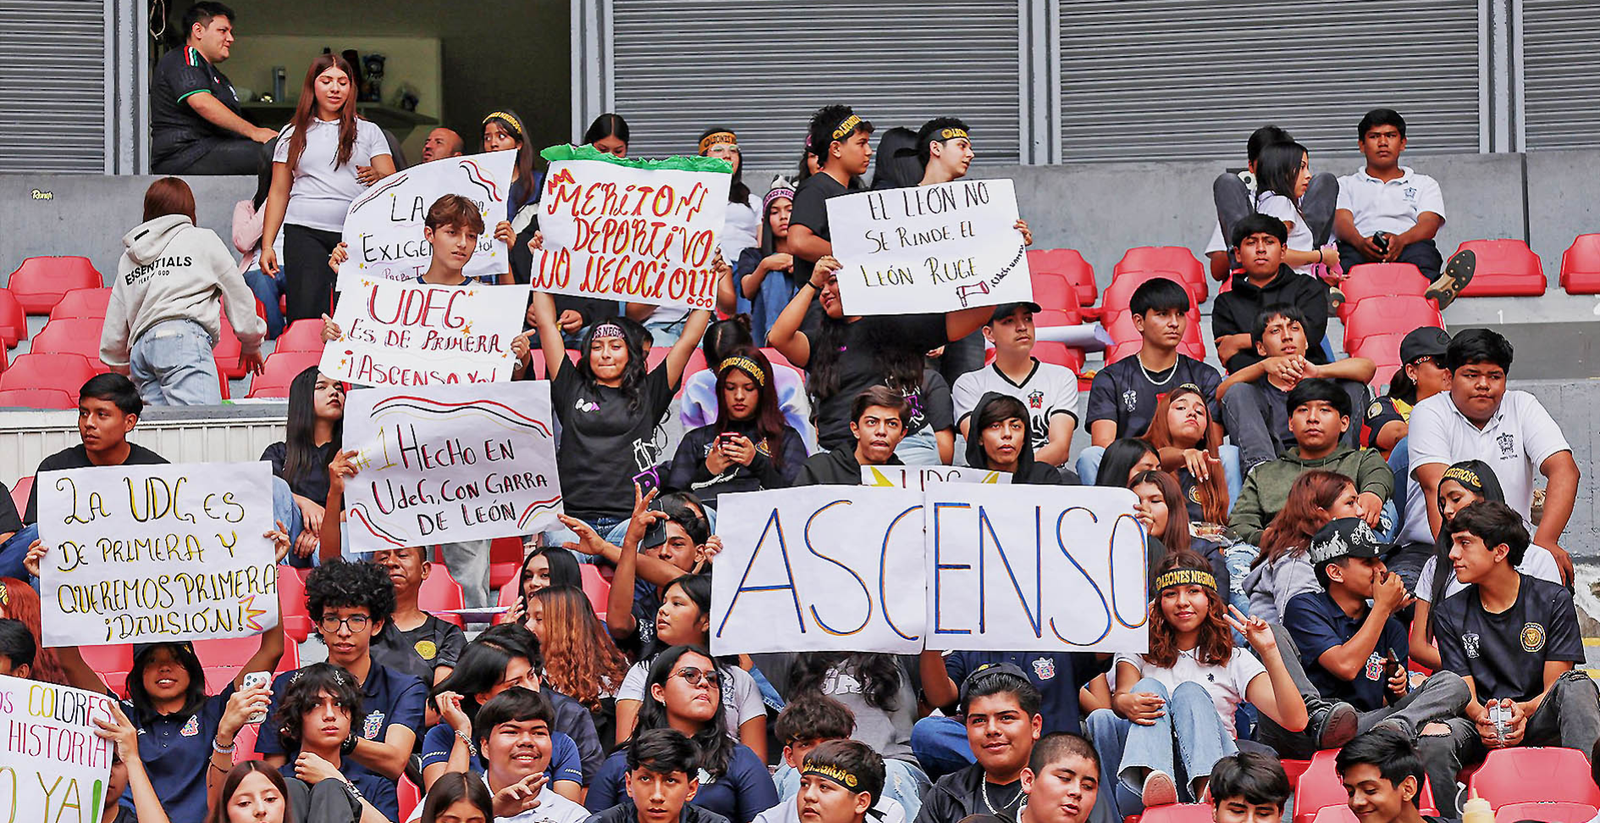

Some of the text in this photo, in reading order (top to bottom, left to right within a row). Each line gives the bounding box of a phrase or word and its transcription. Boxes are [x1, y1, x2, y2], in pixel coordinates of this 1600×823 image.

[867, 181, 990, 221] EL LEÓN NO
[362, 235, 433, 263] EXIGE
[864, 228, 891, 255] SE
[960, 220, 976, 239] EL
[124, 256, 192, 286] ESSENTIALS
[532, 247, 571, 290] NO
[860, 264, 915, 288] LEÓN
[923, 256, 979, 286] RUGE
[366, 284, 467, 329] UDEG
[384, 329, 411, 349] DE
[421, 329, 504, 354] PRIMERA
[484, 438, 516, 462] EN
[484, 471, 549, 494] GARRA
[203, 491, 245, 524] ES
[416, 499, 517, 536] DE LEÓN
[56, 530, 238, 572] DE PRIMERA Y
[57, 574, 175, 616] QUEREMOS
[173, 563, 278, 606] PRIMERA
[716, 499, 1150, 647] ASCENSO
[1161, 570, 1190, 588] LEONES
[28, 684, 112, 728] COLORES
[9, 719, 107, 770] HISTORIA
